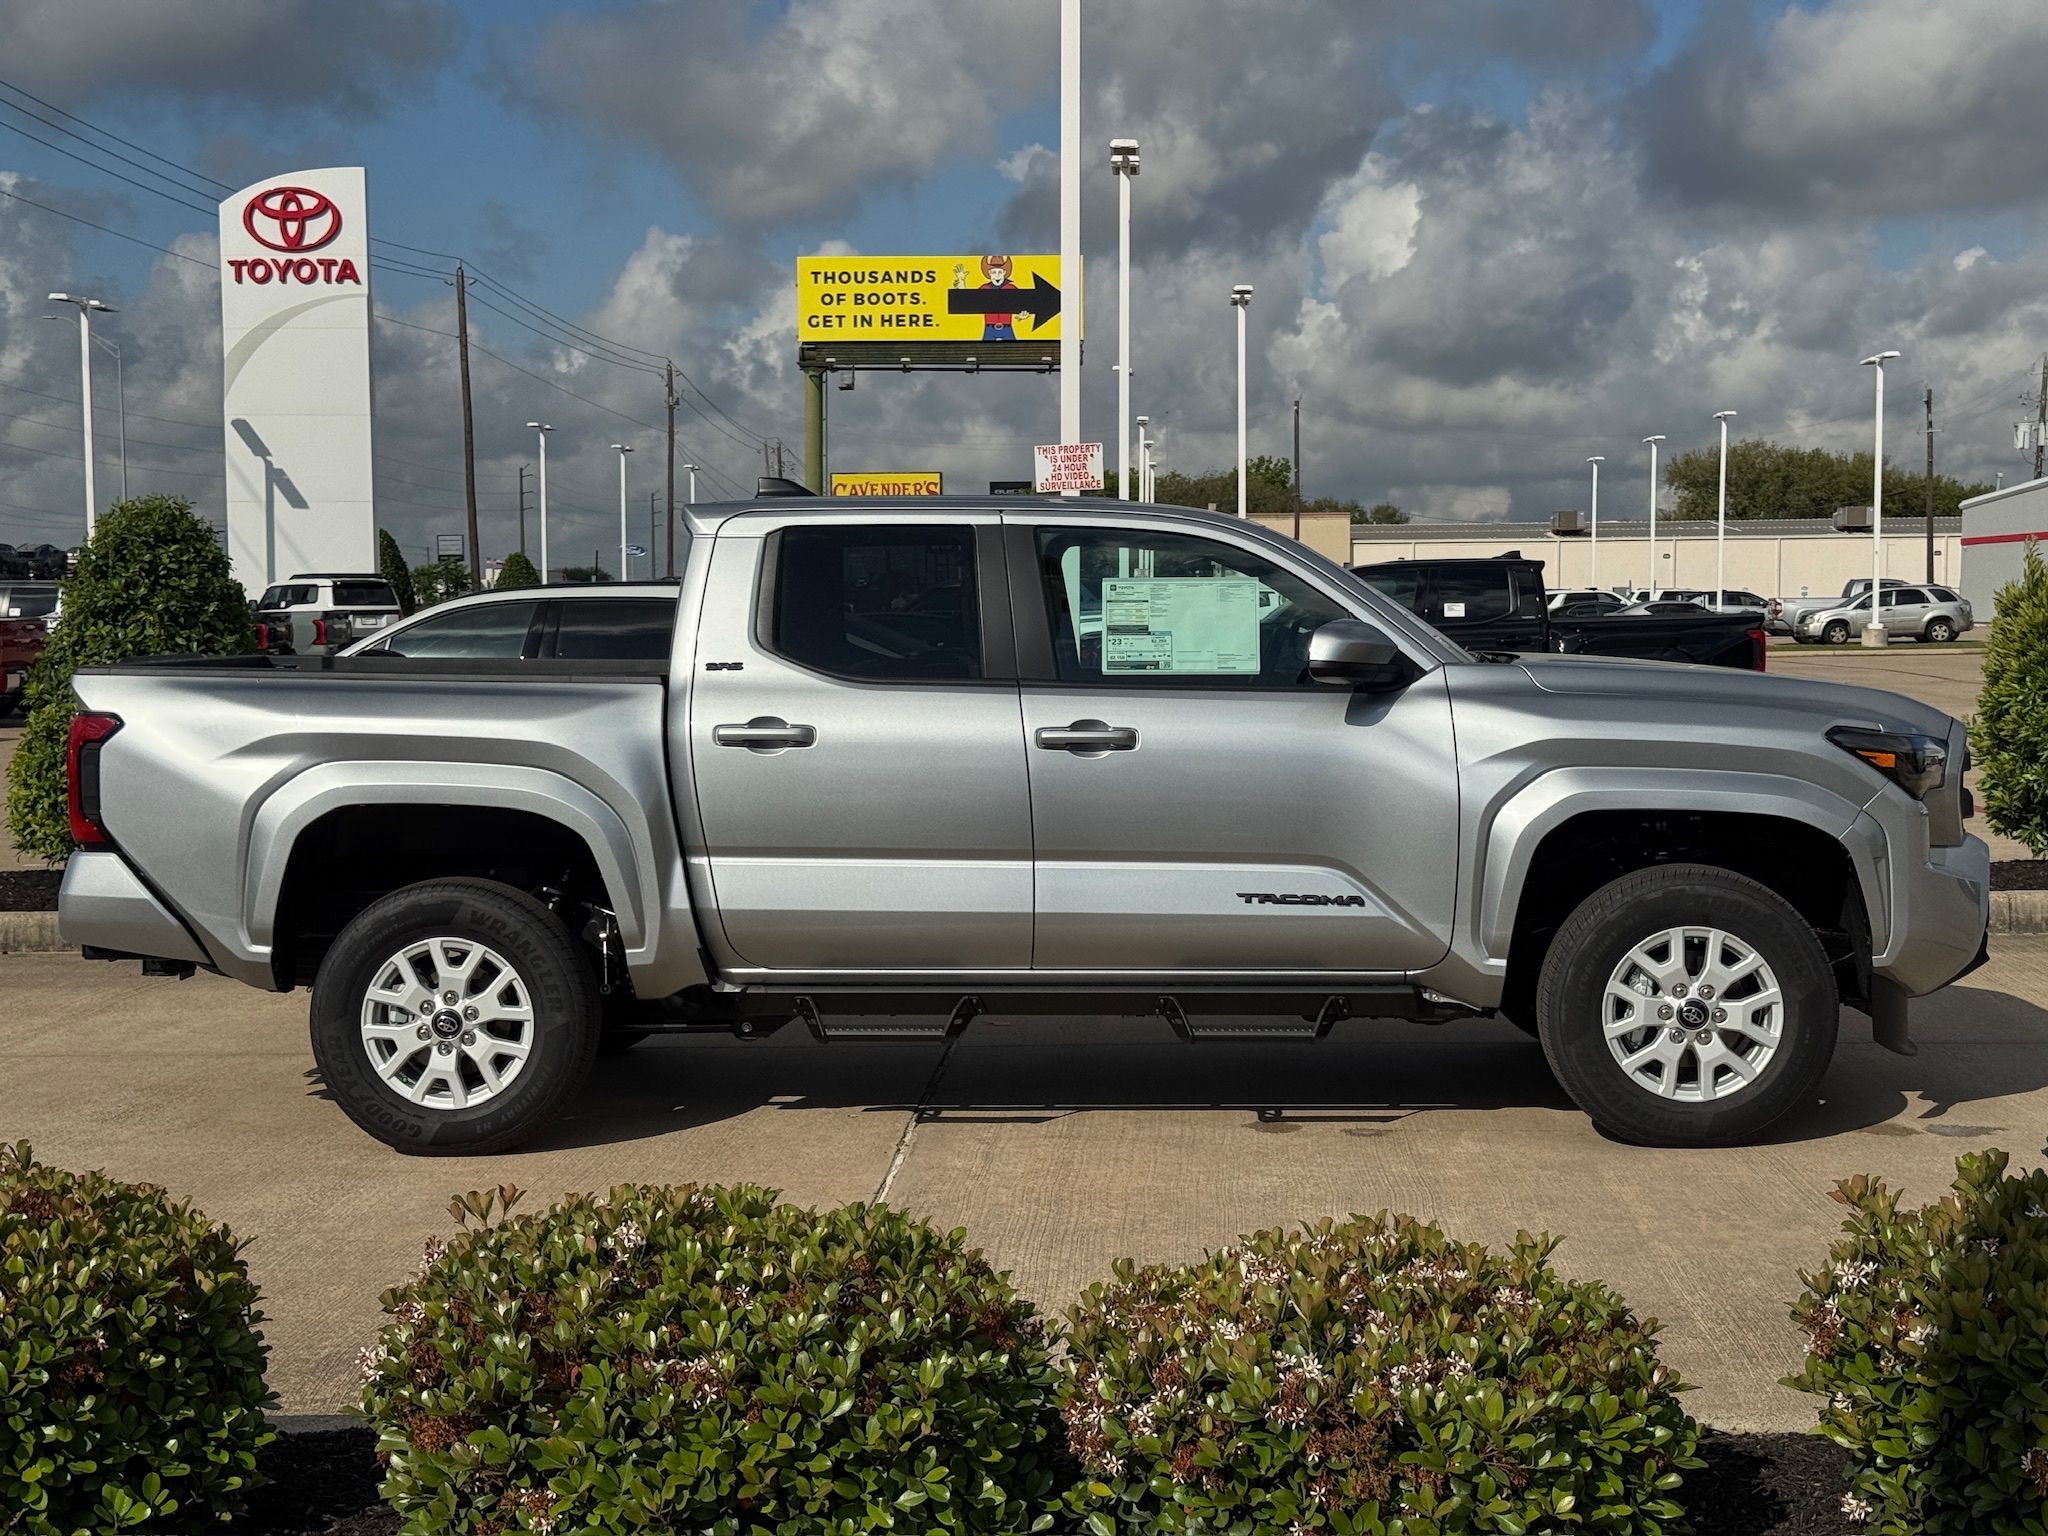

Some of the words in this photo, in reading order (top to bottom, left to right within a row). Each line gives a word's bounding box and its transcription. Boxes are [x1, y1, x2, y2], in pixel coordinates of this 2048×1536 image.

[227, 258, 361, 285] TOYOTA
[811, 270, 936, 284] THOUSANDS
[821, 293, 846, 305] OF
[854, 292, 926, 305] BOOTS.
[808, 315, 846, 328] GET
[853, 315, 873, 328] IN
[881, 314, 940, 327] HERE.
[1037, 446, 1056, 456] THIS
[1058, 444, 1101, 454] PROPERTY
[1060, 454, 1088, 463] UNDER
[1052, 464, 1061, 472] 24
[1064, 463, 1088, 471] HOUR
[1051, 473, 1062, 481] HD
[1064, 471, 1089, 480] VIDEO
[831, 481, 940, 496] CAVENDER'S
[1040, 480, 1101, 491] SURVEILLANCE
[1236, 892, 1366, 907] TACOMA
[469, 909, 564, 1015] WRANGLER
